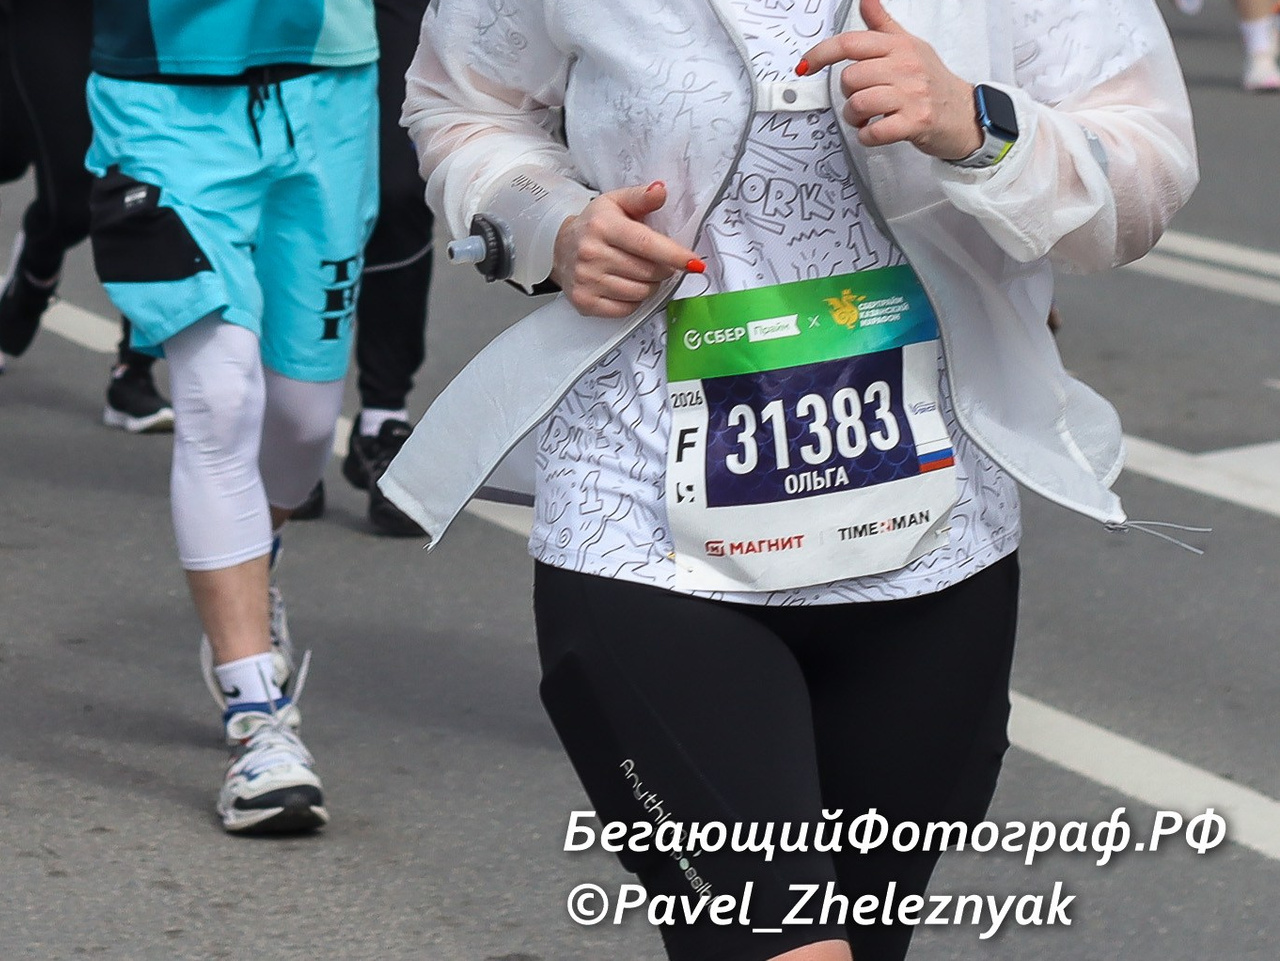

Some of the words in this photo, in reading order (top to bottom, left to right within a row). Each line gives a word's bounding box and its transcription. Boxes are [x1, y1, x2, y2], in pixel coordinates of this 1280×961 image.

[703, 326, 746, 345] СБЕР
[670, 389, 703, 408] 2026
[724, 380, 902, 475] 31383
[676, 427, 699, 462] F
[784, 465, 850, 495] ОЛЬГА
[730, 534, 805, 556] МАГНИТ
